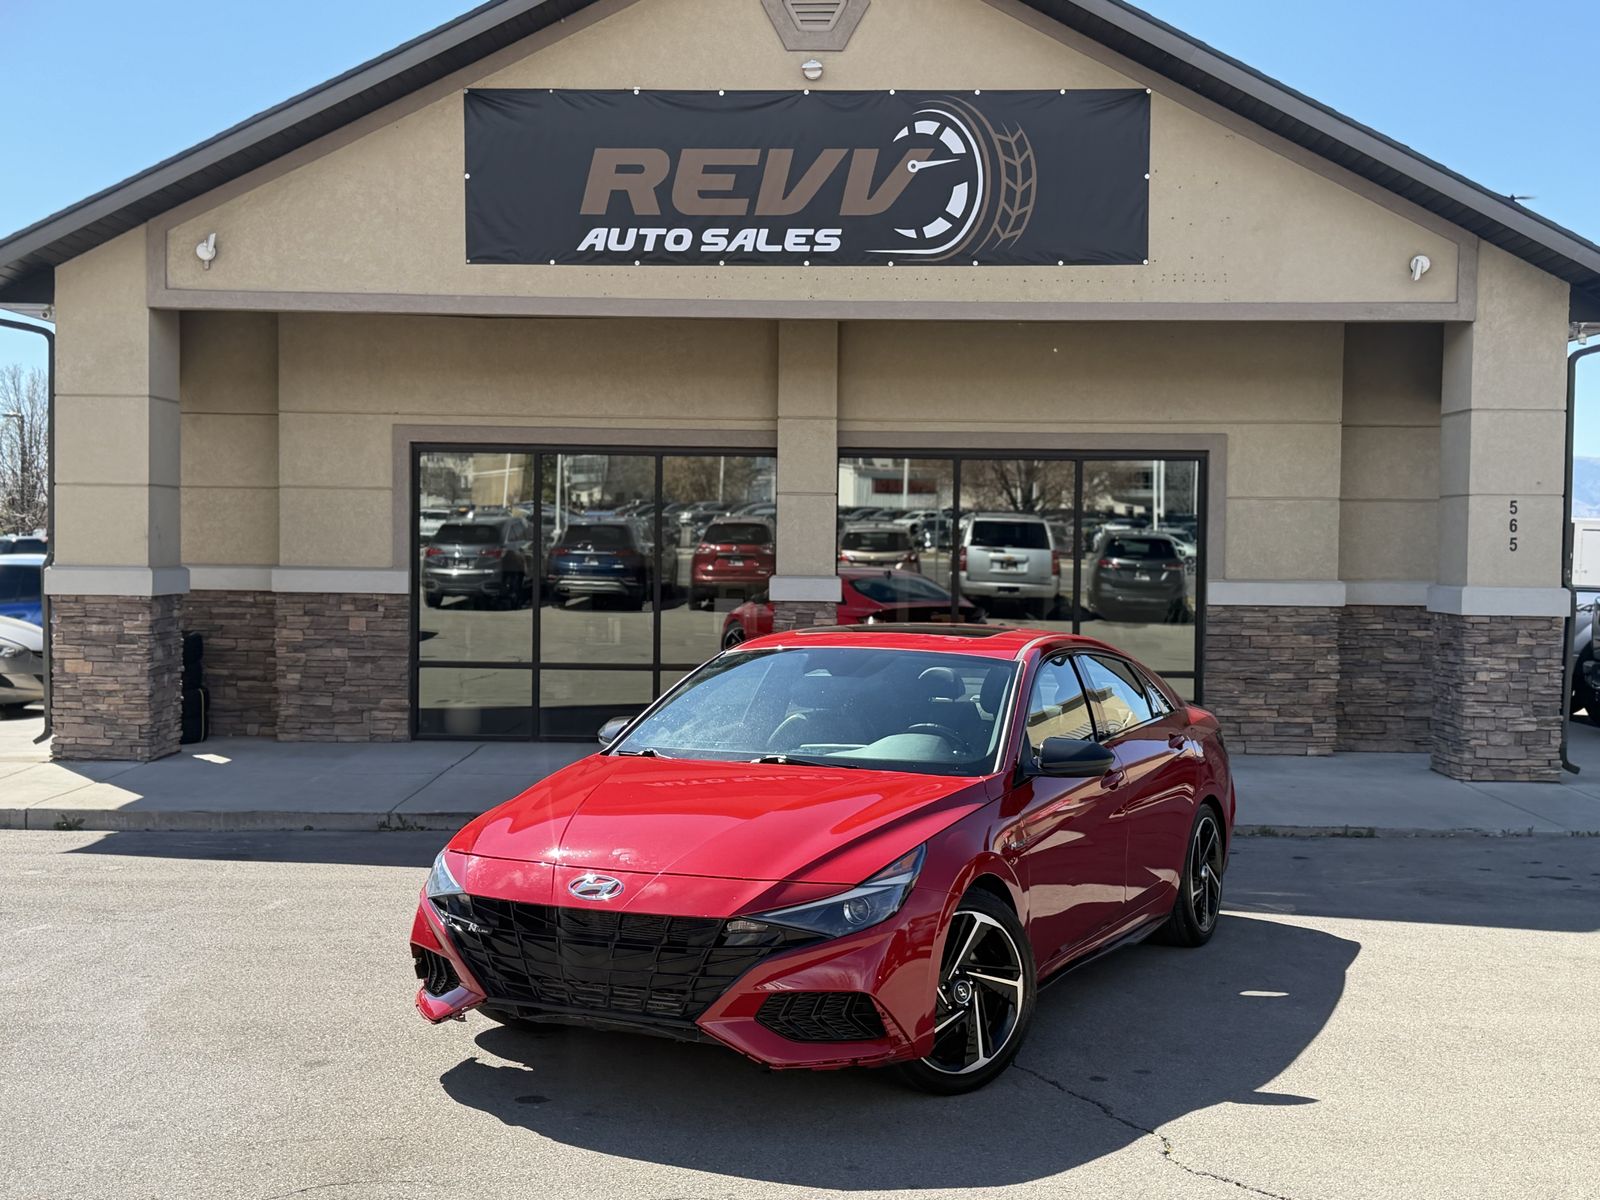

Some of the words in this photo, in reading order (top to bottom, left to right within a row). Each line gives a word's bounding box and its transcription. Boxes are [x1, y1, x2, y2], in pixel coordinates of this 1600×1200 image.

[579, 147, 933, 216] REVV
[576, 228, 693, 252] AUTO
[701, 228, 842, 252] SALES
[1509, 500, 1518, 552] 565
